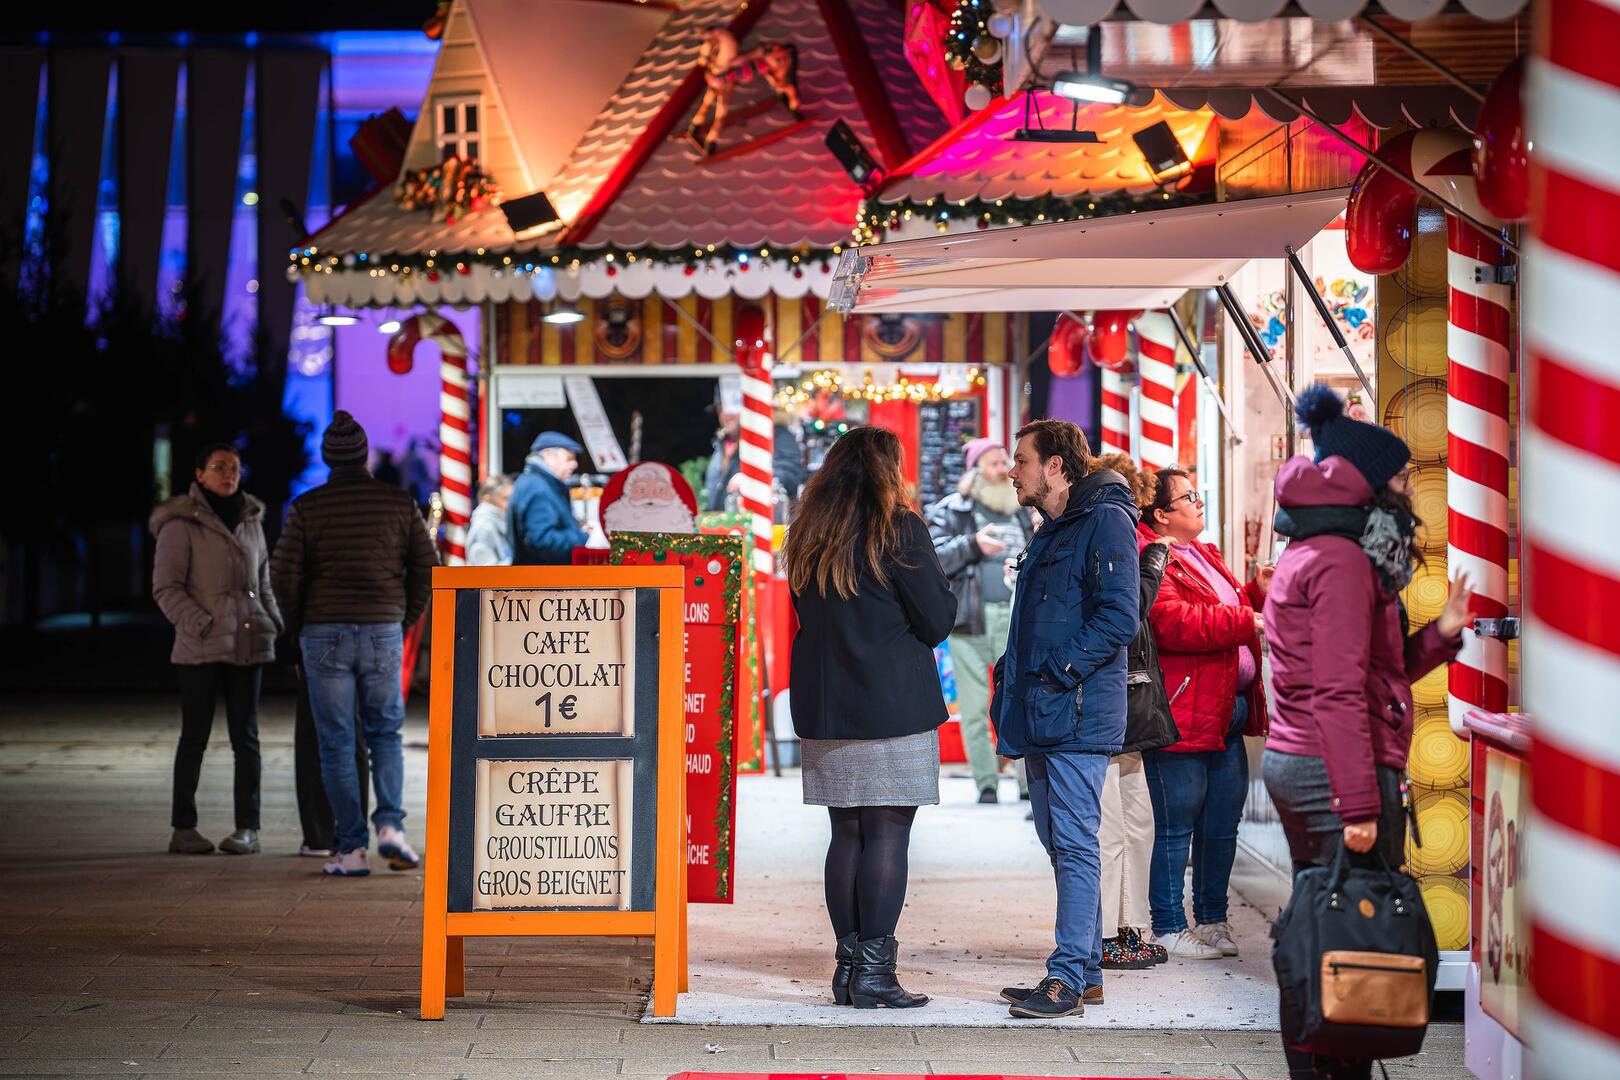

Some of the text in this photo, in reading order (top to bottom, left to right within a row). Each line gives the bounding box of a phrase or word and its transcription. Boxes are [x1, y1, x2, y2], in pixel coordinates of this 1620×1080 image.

[489, 596, 625, 622] VIN CHAUD
[523, 631, 590, 655] CAFE
[488, 663, 626, 688] CHOCOLAT
[535, 692, 578, 728] 1€
[508, 767, 599, 796] CRÊPE
[495, 803, 610, 828] GAUFRE
[486, 836, 619, 861] CROUSTILLONS
[477, 870, 626, 898] GROS BEIGNET
